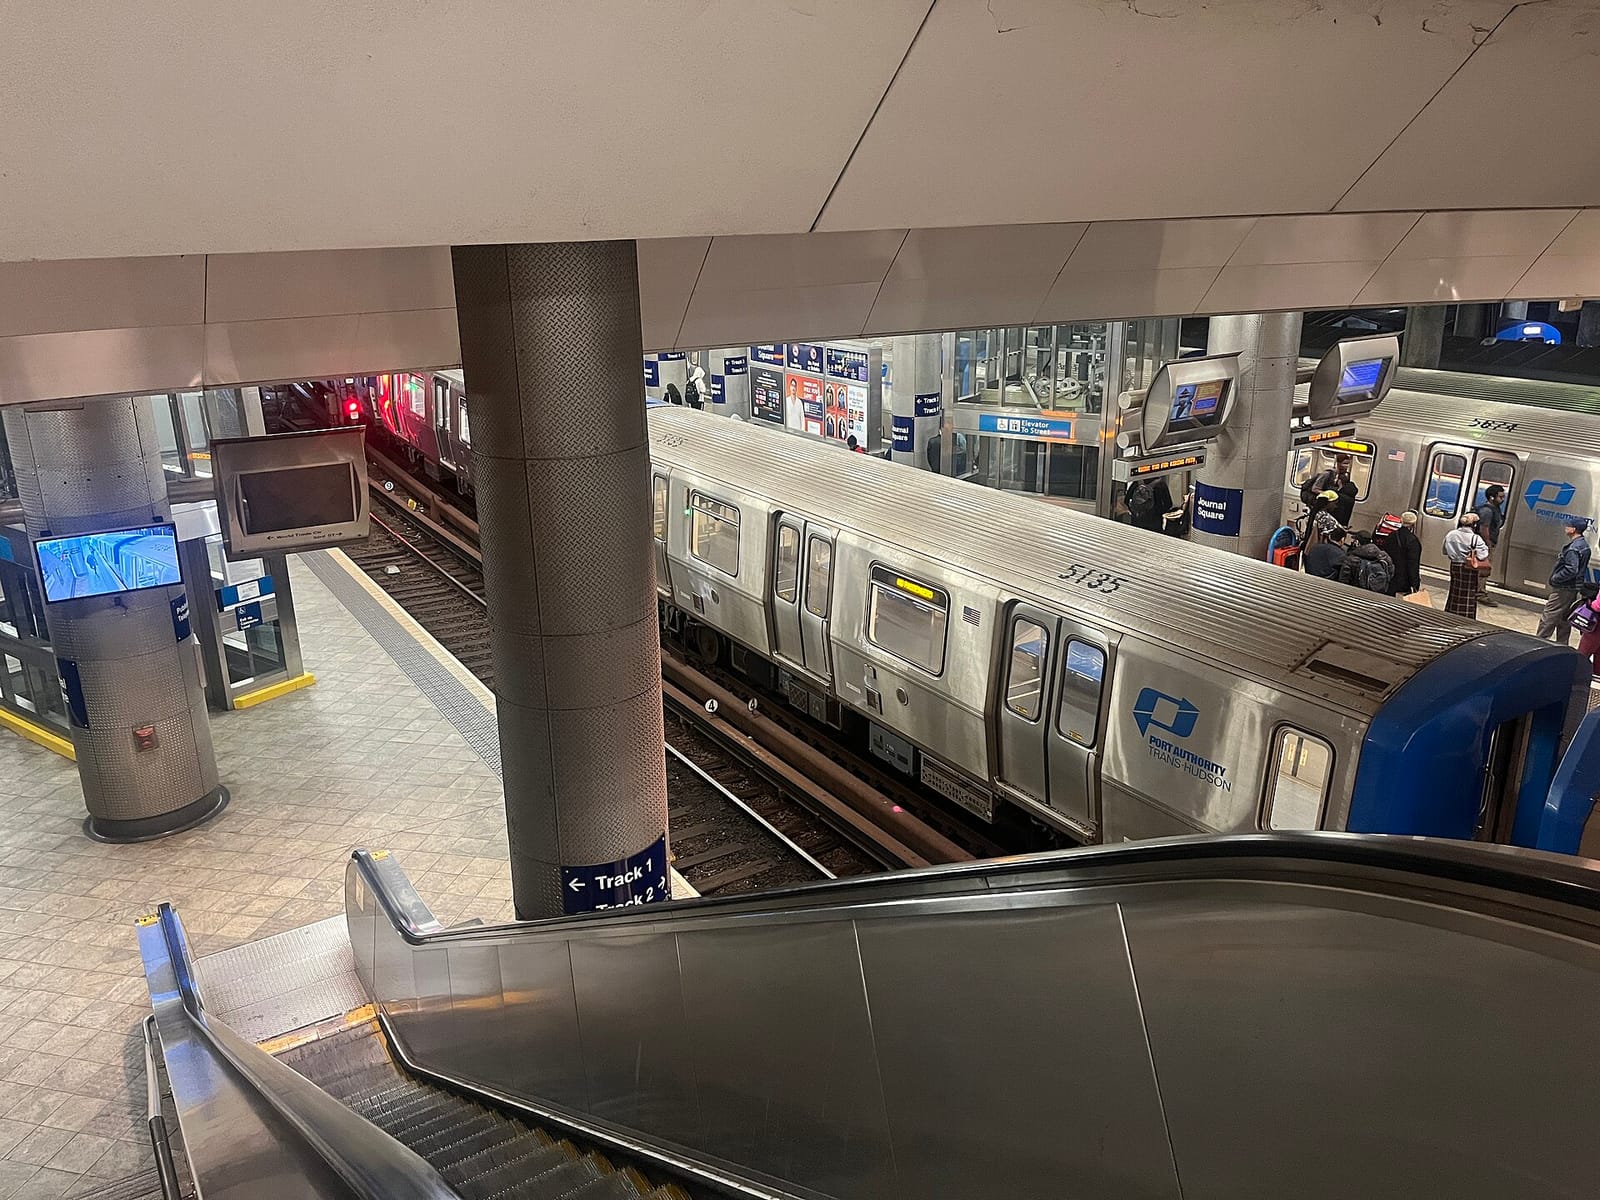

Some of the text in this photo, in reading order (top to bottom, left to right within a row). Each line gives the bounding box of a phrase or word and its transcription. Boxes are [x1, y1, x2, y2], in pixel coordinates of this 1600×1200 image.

[1021, 419, 1049, 429] Elevator
[1030, 427, 1051, 436] Street
[1197, 497, 1227, 511] Journal
[1197, 506, 1225, 521] Square
[1536, 508, 1555, 518] PORT
[1058, 563, 1129, 593] 5135
[1149, 735, 1227, 777] PORT AUTHORITY
[1148, 745, 1233, 793] TRANS-HUDSON
[594, 857, 652, 890] Track 1
[645, 886, 654, 902] 2
